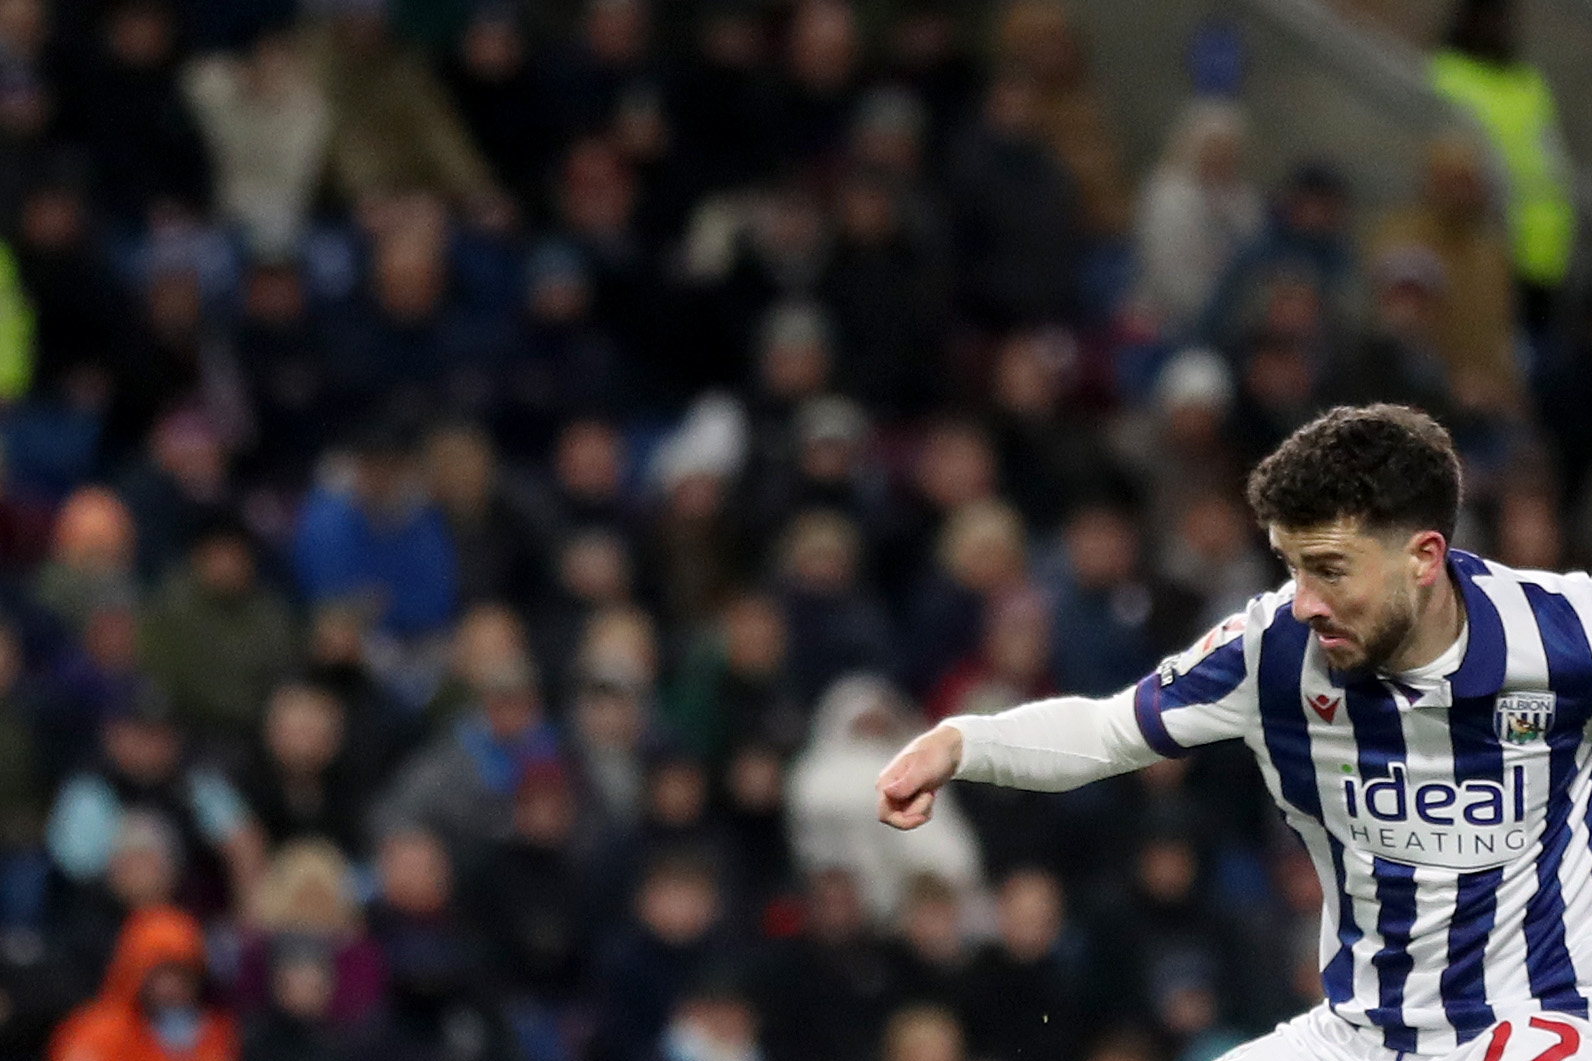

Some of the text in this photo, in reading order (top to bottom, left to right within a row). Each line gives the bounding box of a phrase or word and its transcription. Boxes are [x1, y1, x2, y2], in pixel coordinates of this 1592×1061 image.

[1499, 700, 1551, 711] ALBION
[1342, 763, 1525, 826] ideal
[1350, 824, 1526, 854] HEATING
